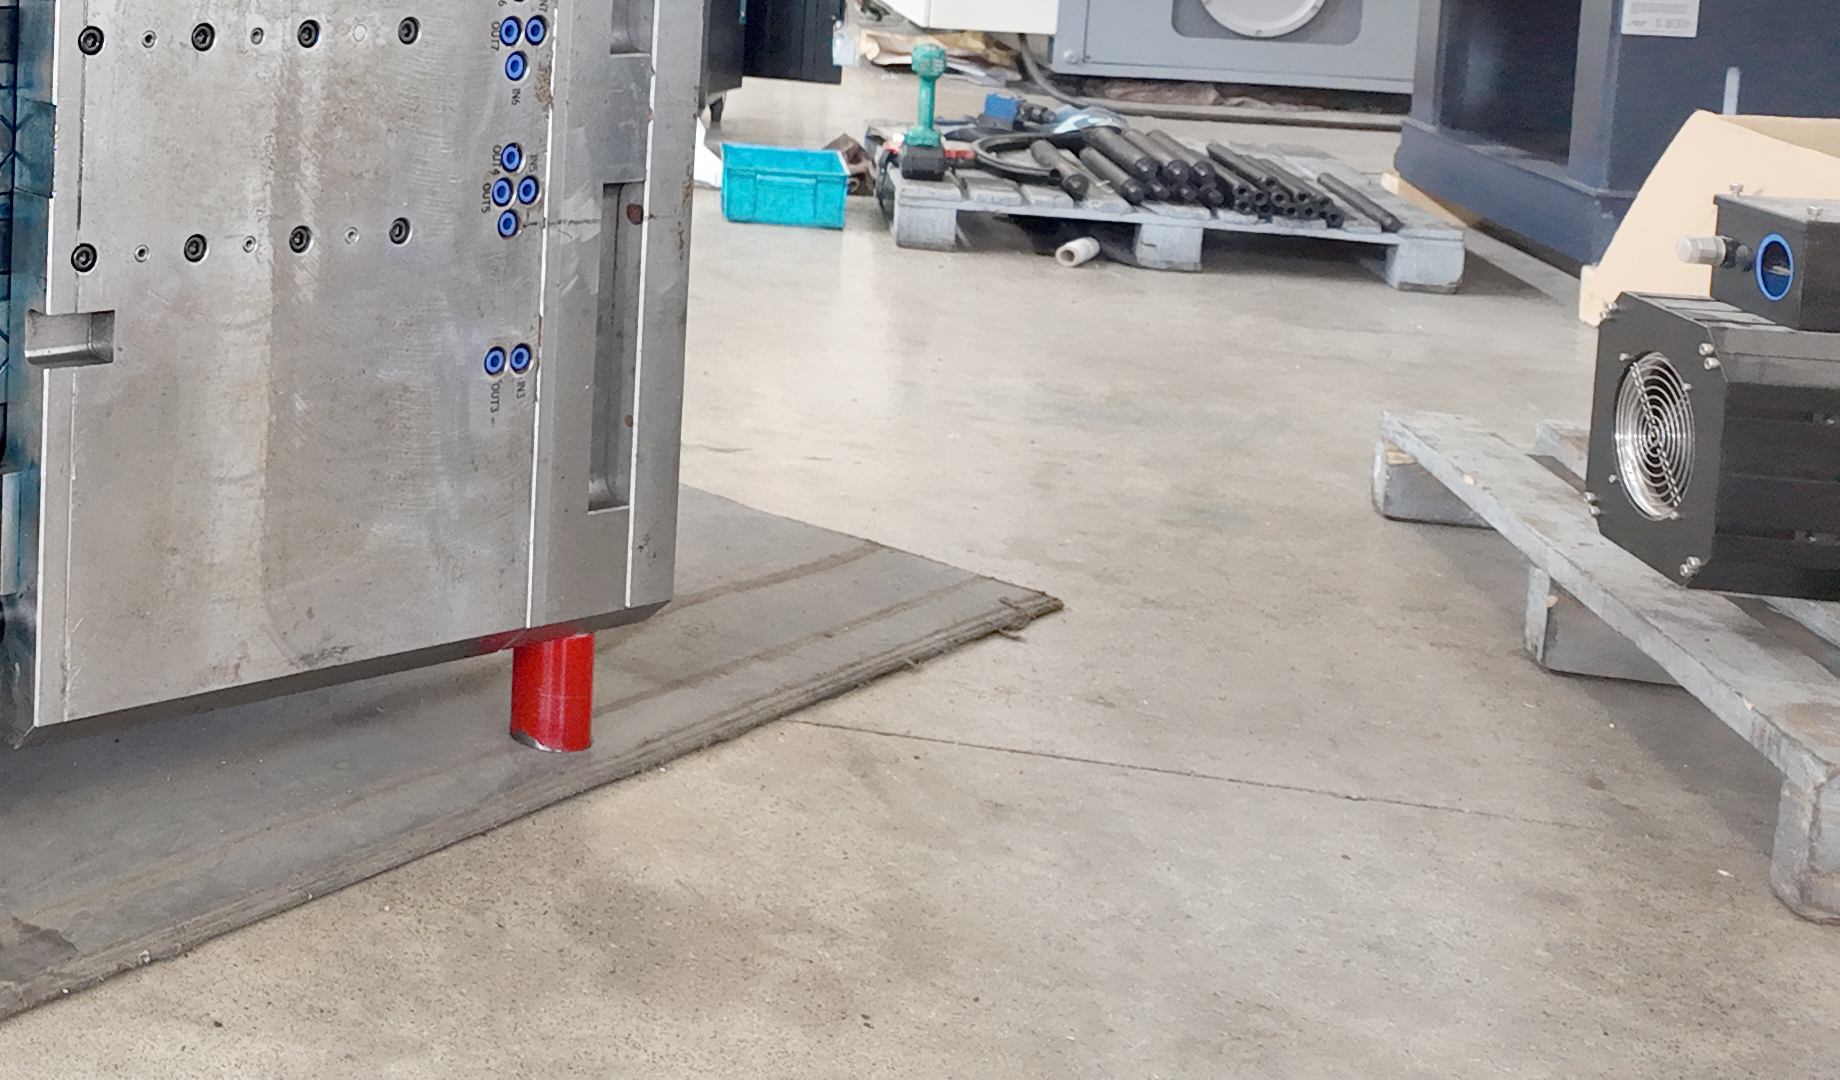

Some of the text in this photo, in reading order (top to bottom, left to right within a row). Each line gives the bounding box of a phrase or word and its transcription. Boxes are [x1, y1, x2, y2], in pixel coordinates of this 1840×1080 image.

[491, 21, 501, 51] OUT7
[511, 88, 521, 106] IN6
[492, 145, 501, 176] OUT4
[529, 154, 538, 173] IN5
[481, 182, 492, 215] OUT5
[491, 383, 501, 413] OUT3
[516, 381, 526, 400] IN3
